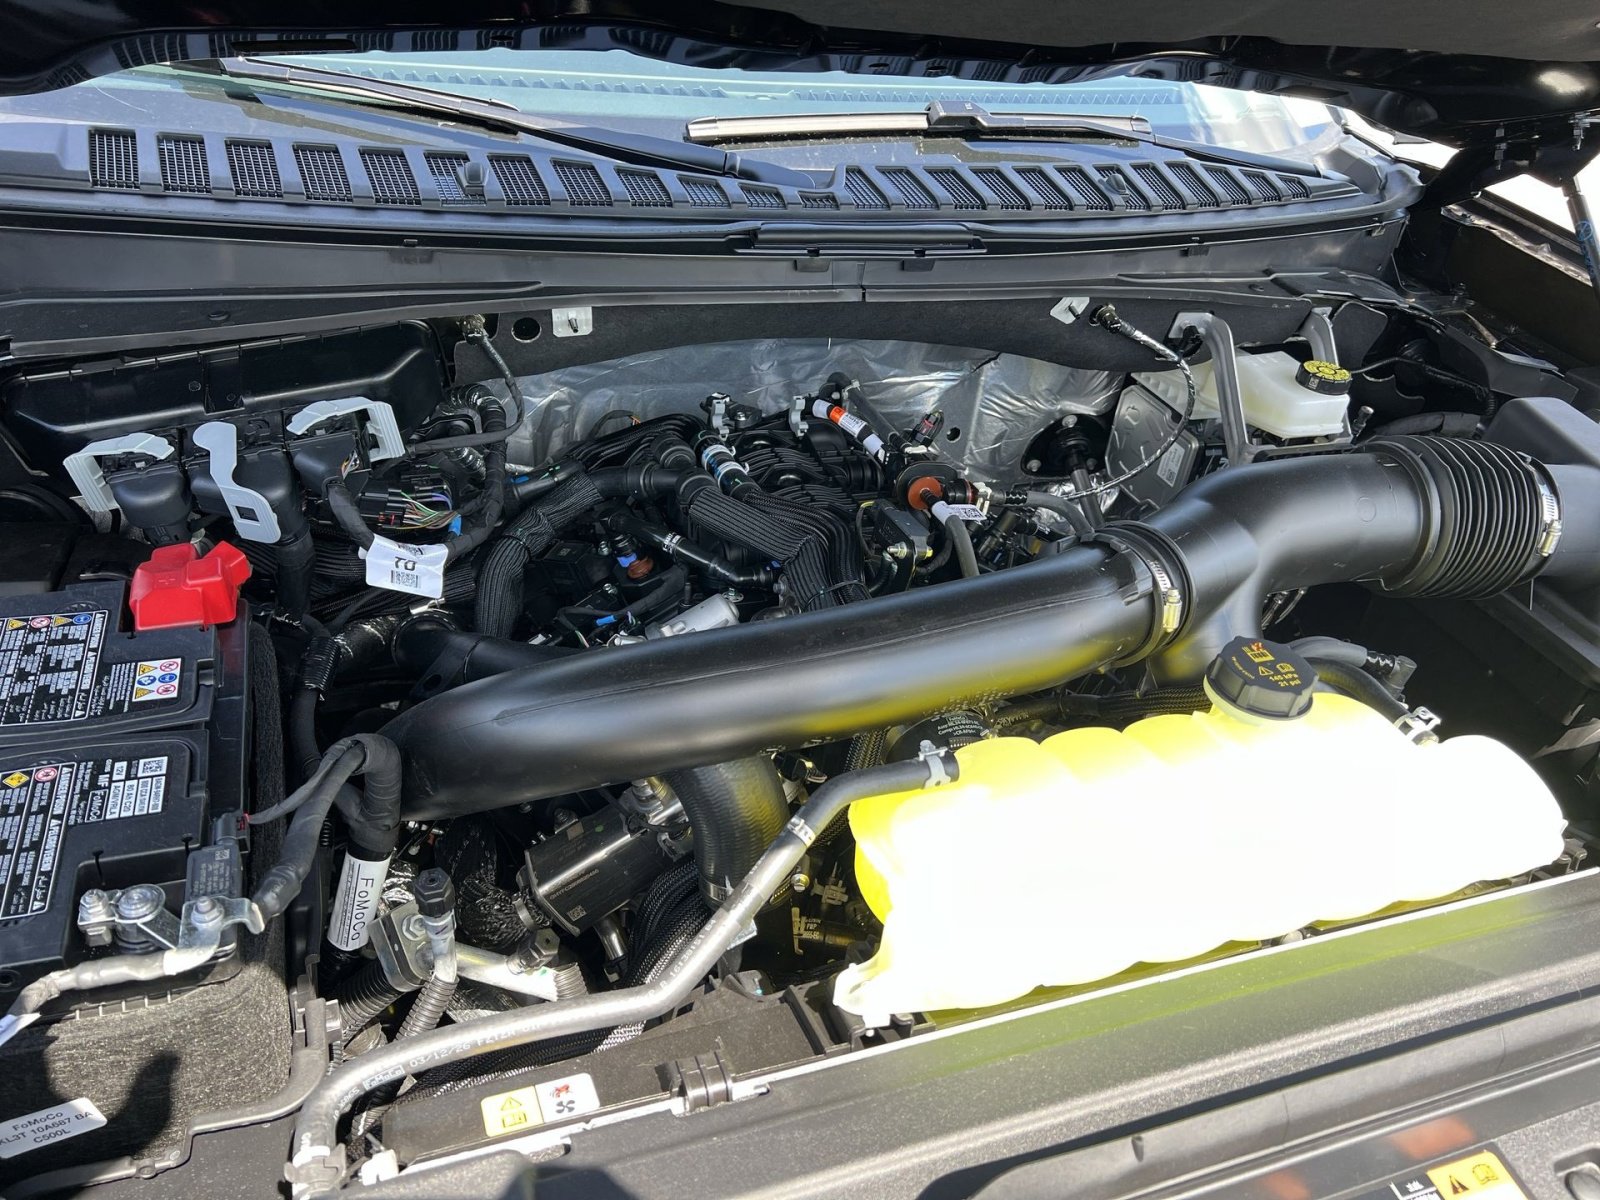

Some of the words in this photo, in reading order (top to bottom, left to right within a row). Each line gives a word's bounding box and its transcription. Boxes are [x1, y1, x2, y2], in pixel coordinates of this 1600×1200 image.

[88, 790, 105, 821] FoMoCo
[351, 877, 375, 941] FoMoCo
[12, 1112, 63, 1131] FoMoCo
[75, 1111, 93, 1121] BA
[33, 1129, 71, 1143] C500L
